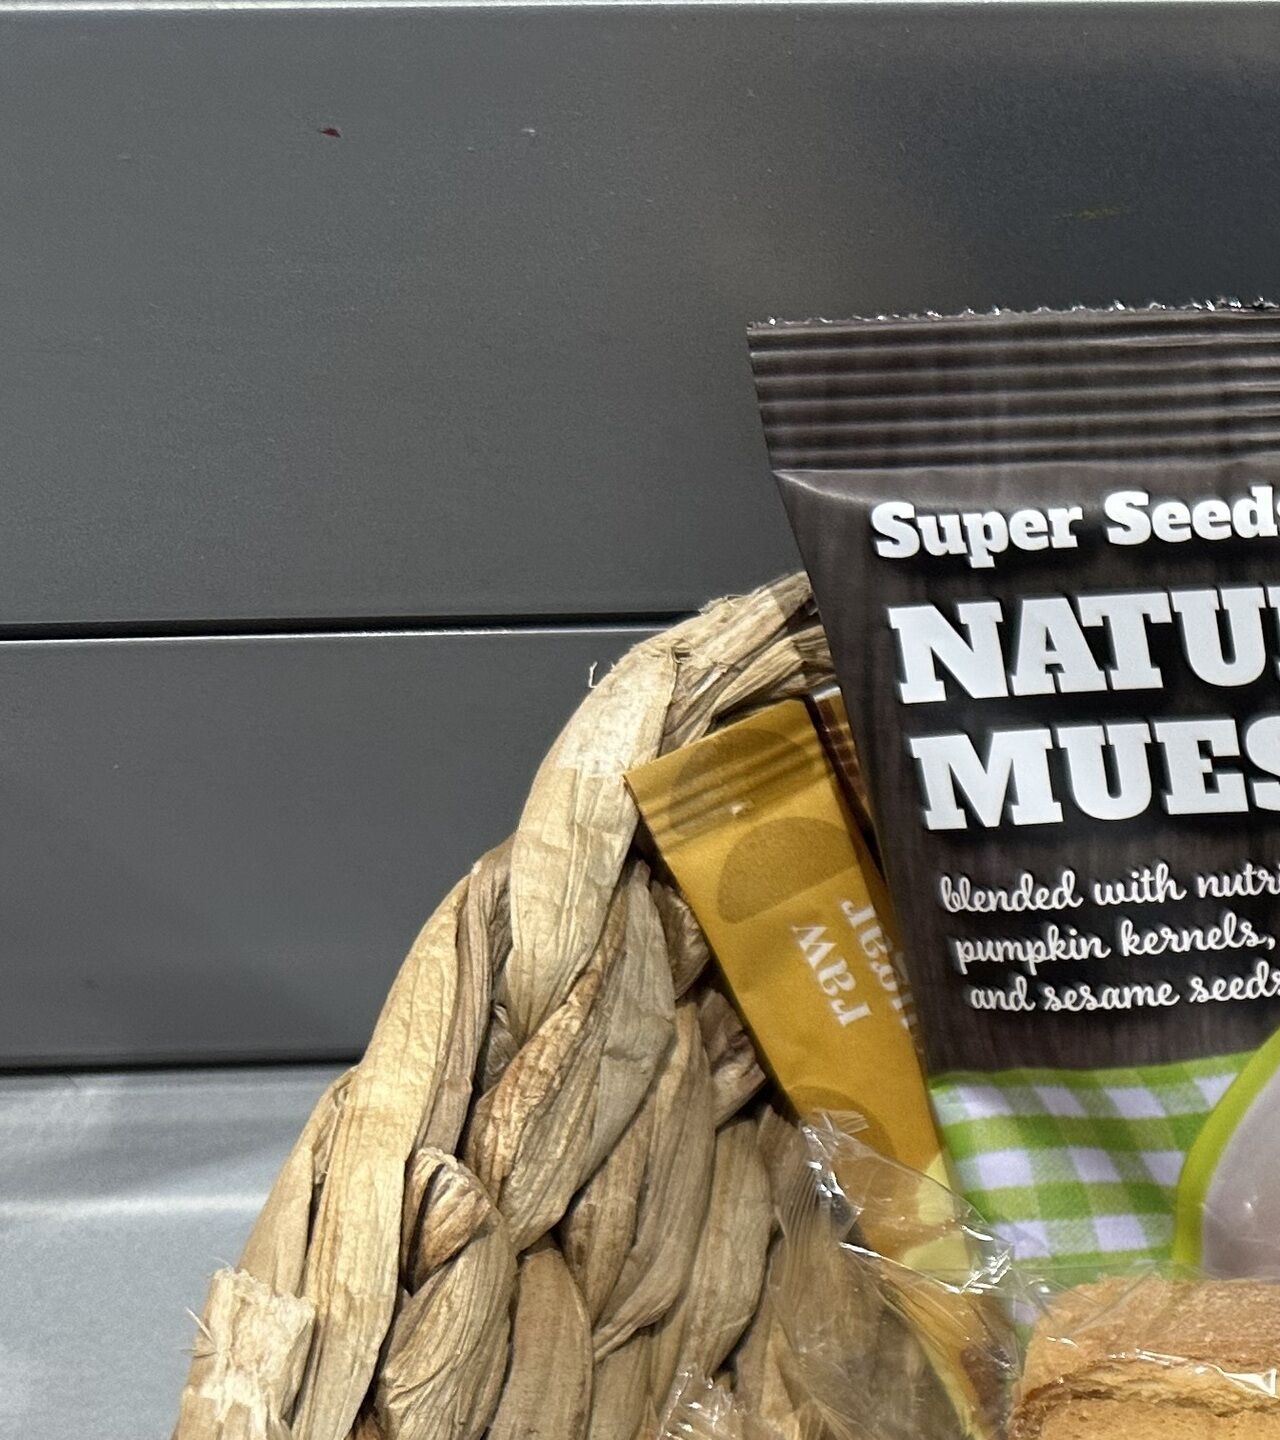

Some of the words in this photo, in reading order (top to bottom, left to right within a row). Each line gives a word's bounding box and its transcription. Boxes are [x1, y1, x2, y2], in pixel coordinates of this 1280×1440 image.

[871, 500, 1083, 569] Super
[941, 870, 1083, 913] blended
[1093, 863, 1186, 906] with
[795, 921, 872, 1027] raw
[953, 924, 1112, 976] pumpkin
[1120, 913, 1276, 958] kernels,
[969, 975, 1037, 1012] and
[1044, 979, 1181, 1012] sesame
